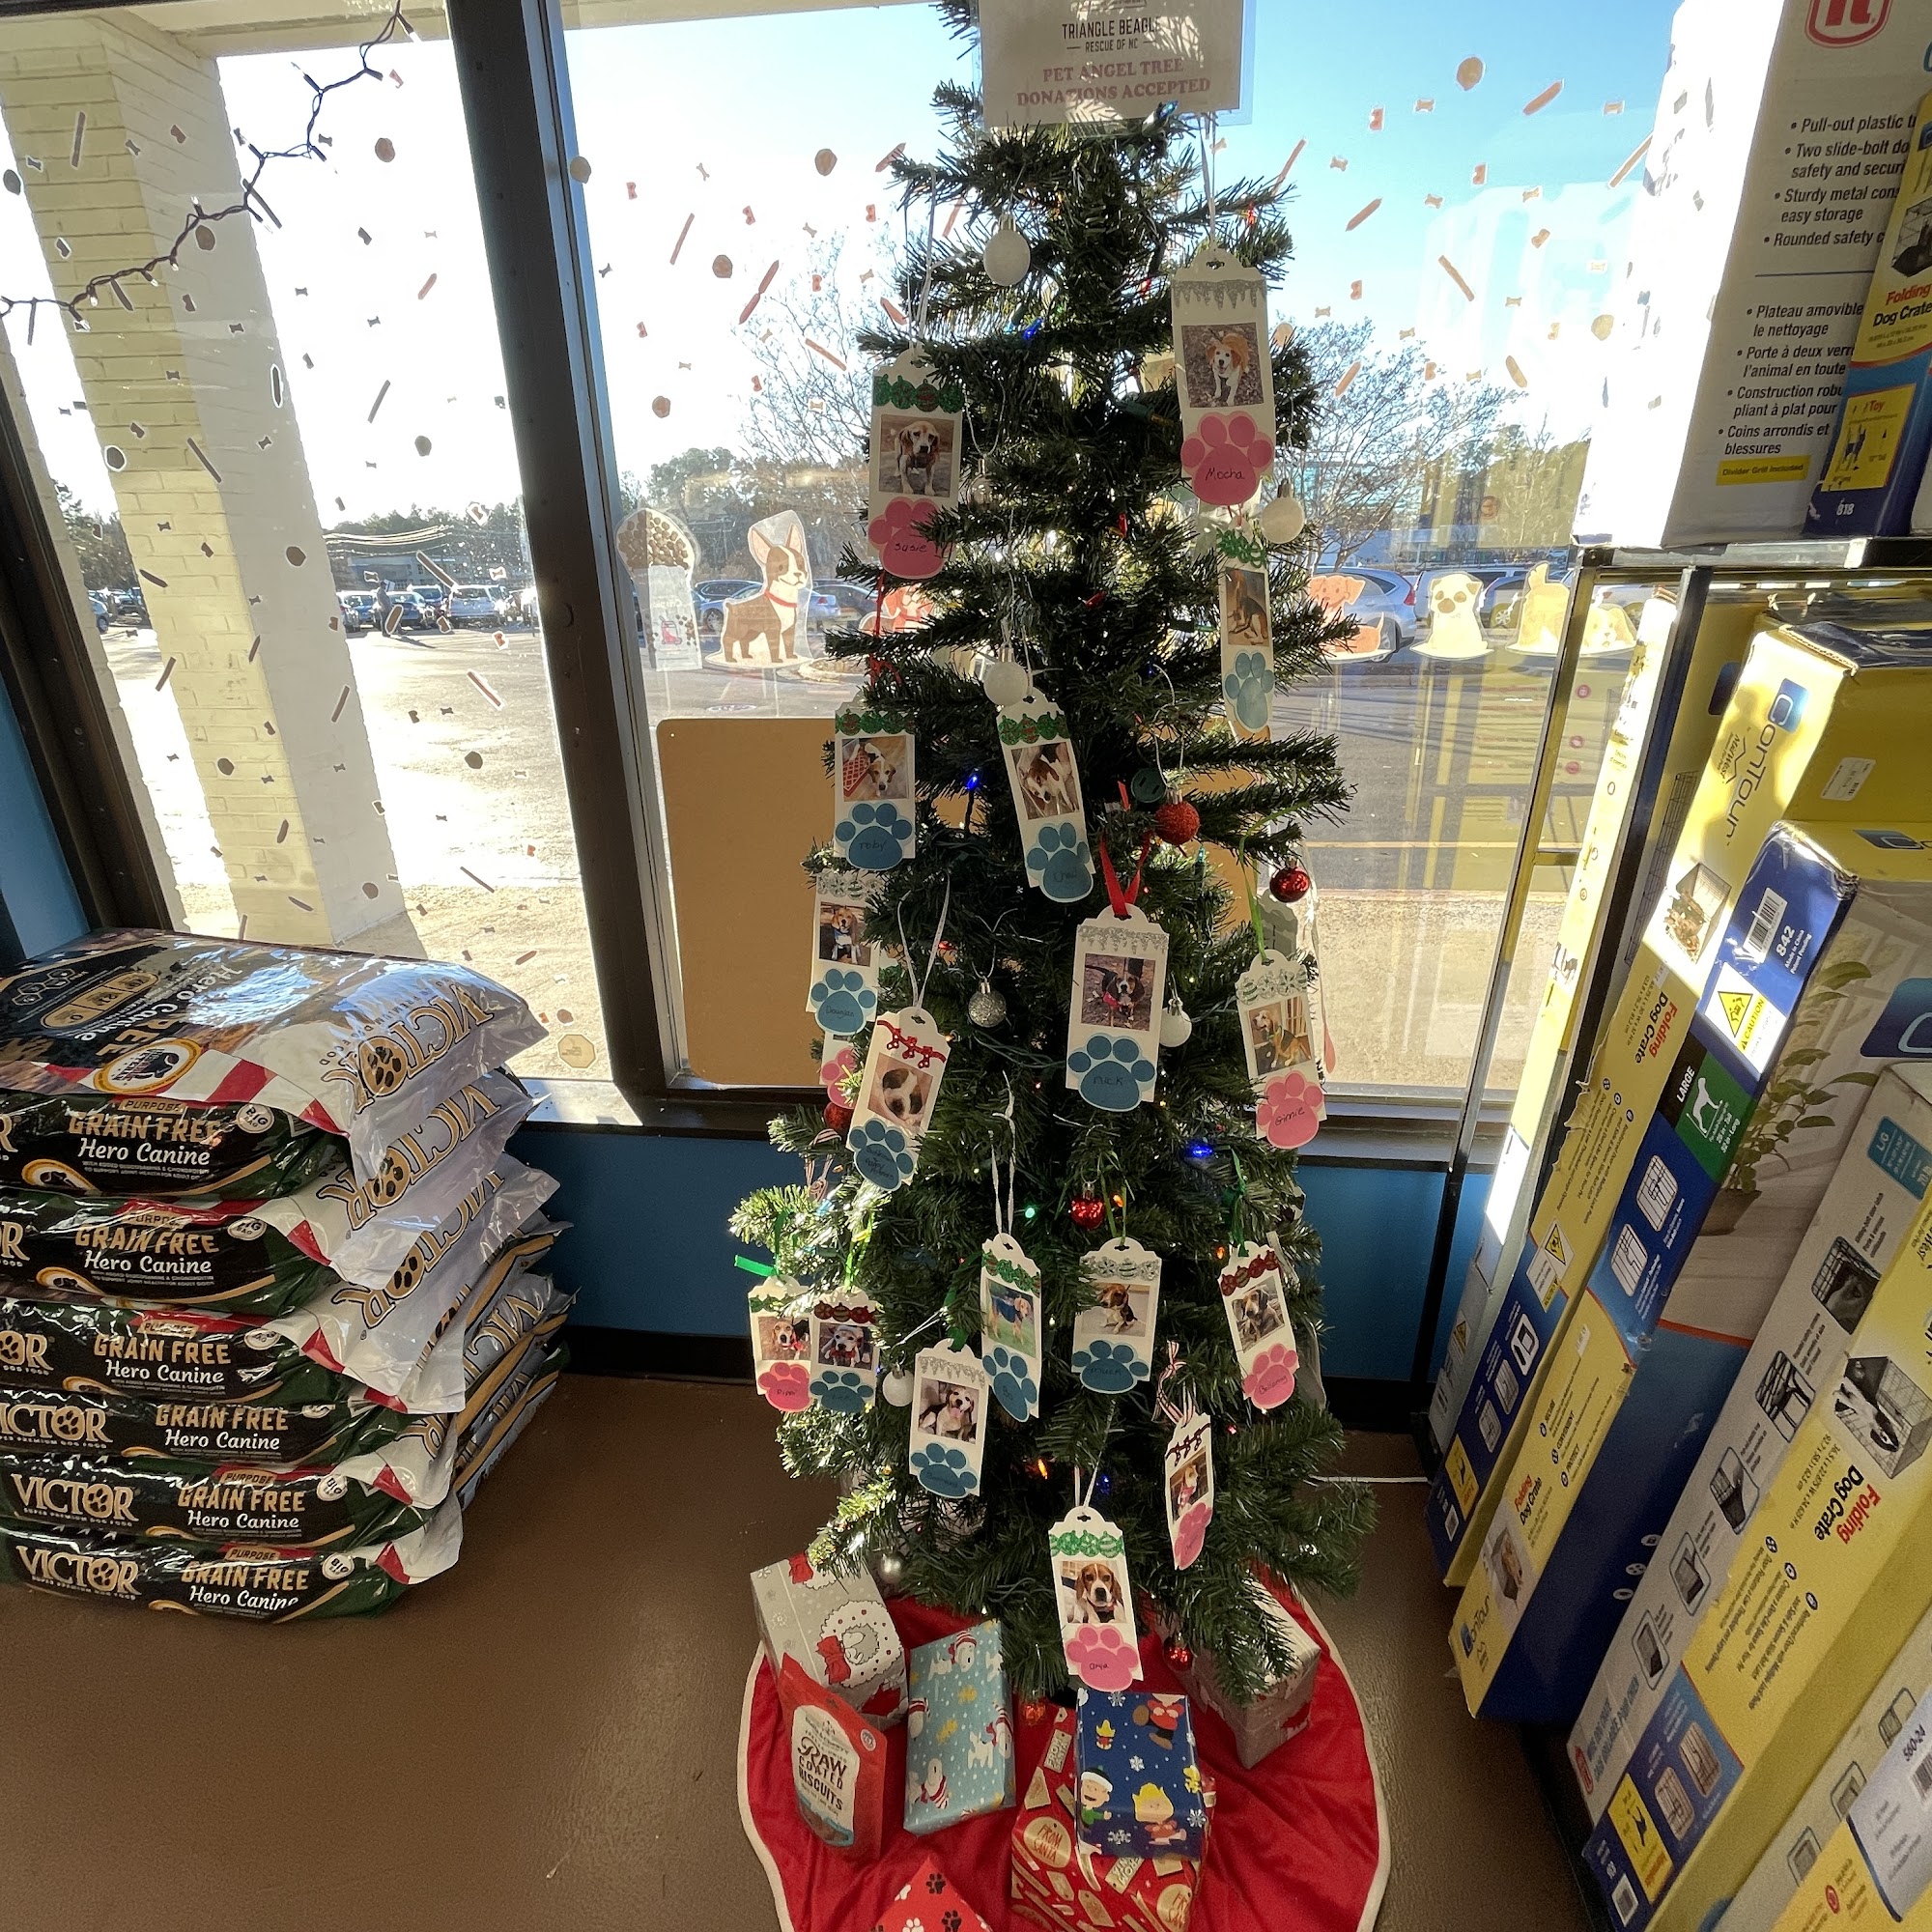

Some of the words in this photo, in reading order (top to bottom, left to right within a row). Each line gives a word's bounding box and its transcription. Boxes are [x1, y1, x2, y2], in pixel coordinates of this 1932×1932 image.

[1062, 20, 1115, 41] TRIANGLE
[1085, 40, 1114, 53] RESCUE
[1117, 39, 1125, 50] OF
[1128, 38, 1138, 49] NC
[1043, 67, 1074, 83] PET
[1079, 62, 1136, 81] ANGEL
[1139, 56, 1184, 75] TREE
[1016, 82, 1119, 106] DONATIONS
[1122, 77, 1211, 99] ACCEPTED
[1801, 116, 1854, 132] Pull-out
[1857, 115, 1903, 133] plastic
[1797, 144, 1821, 158] Two
[1825, 140, 1889, 156] slide-bolt
[1791, 163, 1833, 181] safety
[1835, 162, 1861, 177] and
[1784, 188, 1827, 206] Sturdy
[1830, 185, 1867, 201] metal
[1780, 211, 1811, 224] easy
[1813, 208, 1863, 223] storage
[1774, 233, 1831, 247] Rounded
[1833, 230, 1874, 247] safety
[1886, 283, 1932, 306] Folding
[1756, 304, 1803, 319] Plateau
[1806, 302, 1863, 317] amovible
[1873, 310, 1898, 327] Dog
[1899, 301, 1932, 321] Crate
[1753, 324, 1764, 337] le
[1767, 323, 1829, 338] nettoyage
[1747, 346, 1778, 359] Porte
[1781, 345, 1790, 358] à
[1793, 344, 1823, 357] deux
[1743, 363, 1794, 378] l'animal
[1796, 365, 1811, 376] en
[1814, 363, 1846, 375] toute
[1737, 385, 1813, 399] Construction
[1733, 404, 1768, 419] pliant
[1771, 403, 1778, 415] à
[1780, 403, 1805, 418] plat
[1807, 404, 1837, 417] pour
[1727, 425, 1760, 438] Coins
[1763, 424, 1813, 437] arrondis
[1817, 423, 1830, 436] et
[1724, 442, 1781, 455] blessures
[1205, 468, 1246, 481] Mocha
[1775, 925, 1796, 956] 842
[177, 964, 242, 1001] Hero
[1646, 991, 1668, 1023] Dog
[1743, 999, 1765, 1039] CAUTION
[74, 1003, 179, 1041] Canine
[1649, 1002, 1678, 1058] Folding
[321, 983, 495, 1114] VICTOR
[1635, 1022, 1656, 1065] Crate
[1676, 1065, 1695, 1103] LARGE
[69, 1111, 144, 1139] GRAIN
[156, 1118, 221, 1144] FREE
[78, 1138, 128, 1161] Hero
[136, 1143, 211, 1166] Canine
[75, 1224, 145, 1253] GRAIN
[155, 1234, 220, 1255] FREE
[84, 1250, 131, 1270] Hero
[139, 1256, 212, 1273] Canine
[94, 1333, 165, 1363] GRAIN
[175, 1341, 232, 1366] FREE
[105, 1360, 151, 1380] Hero
[156, 1365, 225, 1384] Canine
[156, 1404, 227, 1430] GRAIN
[233, 1405, 289, 1431] FREE
[165, 1429, 210, 1449] Hero
[215, 1433, 280, 1450] Canine
[225, 1472, 273, 1484] PURPOSE
[1833, 1464, 1864, 1495] Dog
[11, 1473, 139, 1521] VICTOR
[178, 1485, 243, 1509] GRAIN
[251, 1489, 305, 1512] FREE
[187, 1510, 229, 1528] Hero
[237, 1513, 299, 1529] Canine
[1813, 1492, 1845, 1542] Crate
[1836, 1484, 1882, 1545] Folding
[230, 1548, 276, 1560] PURPOSE
[15, 1546, 142, 1596] VICTOR
[181, 1561, 247, 1586] GRAIN
[253, 1567, 309, 1591] FREE
[189, 1585, 231, 1605] Hero
[798, 1736, 847, 1777] RAW
[799, 1756, 843, 1789] COATED
[799, 1765, 843, 1810] BISCUITS
